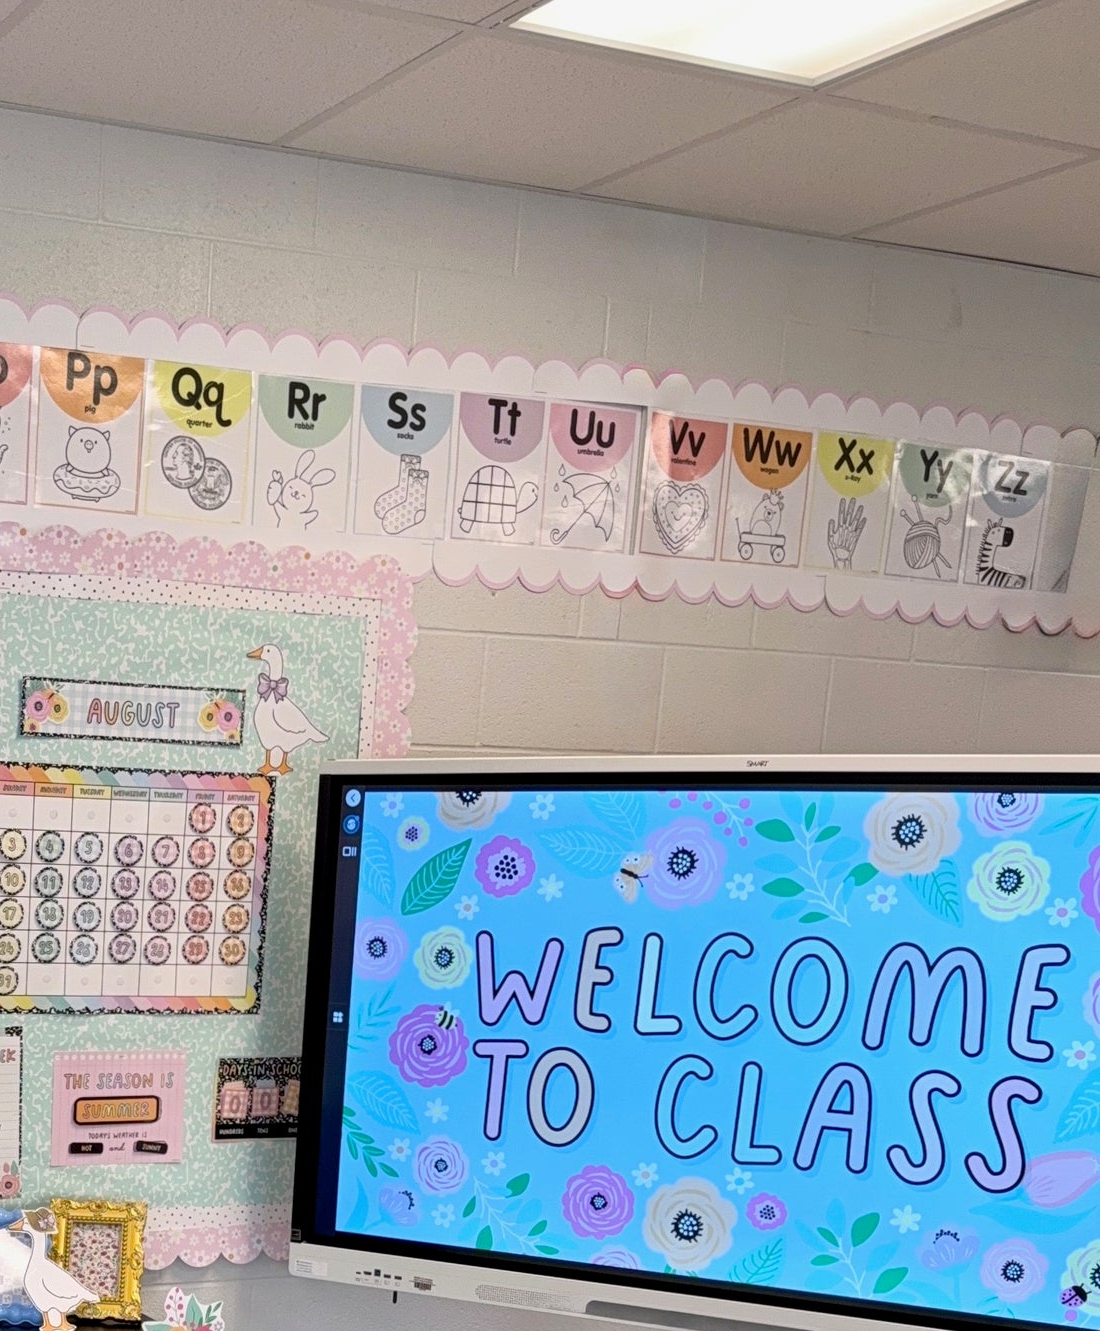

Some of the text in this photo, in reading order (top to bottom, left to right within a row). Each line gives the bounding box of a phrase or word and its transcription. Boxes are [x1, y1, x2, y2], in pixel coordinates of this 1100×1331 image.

[66, 352, 118, 406] Pp
[84, 404, 96, 414] pig
[171, 367, 232, 427] Qq
[287, 381, 327, 421] Rr
[387, 392, 427, 432] Ss
[186, 418, 213, 430] quarter
[294, 421, 315, 431] rabbit
[488, 398, 521, 436] Tt
[570, 408, 615, 448] Uu
[397, 432, 414, 440] socks
[669, 420, 705, 457] Vv
[744, 428, 802, 467] Ww
[834, 437, 875, 475] Xx
[920, 449, 953, 493] Yy
[994, 460, 1030, 496] Zz
[87, 698, 180, 728] AUGUST
[746, 760, 769, 768] SMART
[8, 837, 16, 852] 3
[46, 839, 54, 854] 4
[84, 840, 93, 855] 5
[124, 844, 133, 858] 6
[162, 844, 170, 858] 7
[237, 844, 245, 858] 9
[5, 872, 19, 887] 10
[42, 875, 56, 890] 11
[80, 875, 94, 890] 12
[119, 876, 132, 892] 13
[2, 906, 16, 921] 17
[42, 907, 56, 921] 18
[80, 909, 94, 924] 19
[118, 908, 132, 924] 20
[155, 910, 169, 924] 21
[0, 941, 14, 956] 24
[39, 940, 53, 956] 25
[76, 941, 90, 958] 26
[116, 940, 130, 955] 27
[224, 943, 240, 958] 30
[475, 926, 1072, 1063] WELCOME
[64, 1072, 175, 1090] THE SEASON IS
[222, 1064, 302, 1076] DAYS IN SCHO
[82, 1102, 150, 1120] SUMMER
[472, 1037, 1043, 1194] TO CLASS
[108, 1142, 126, 1152] and
